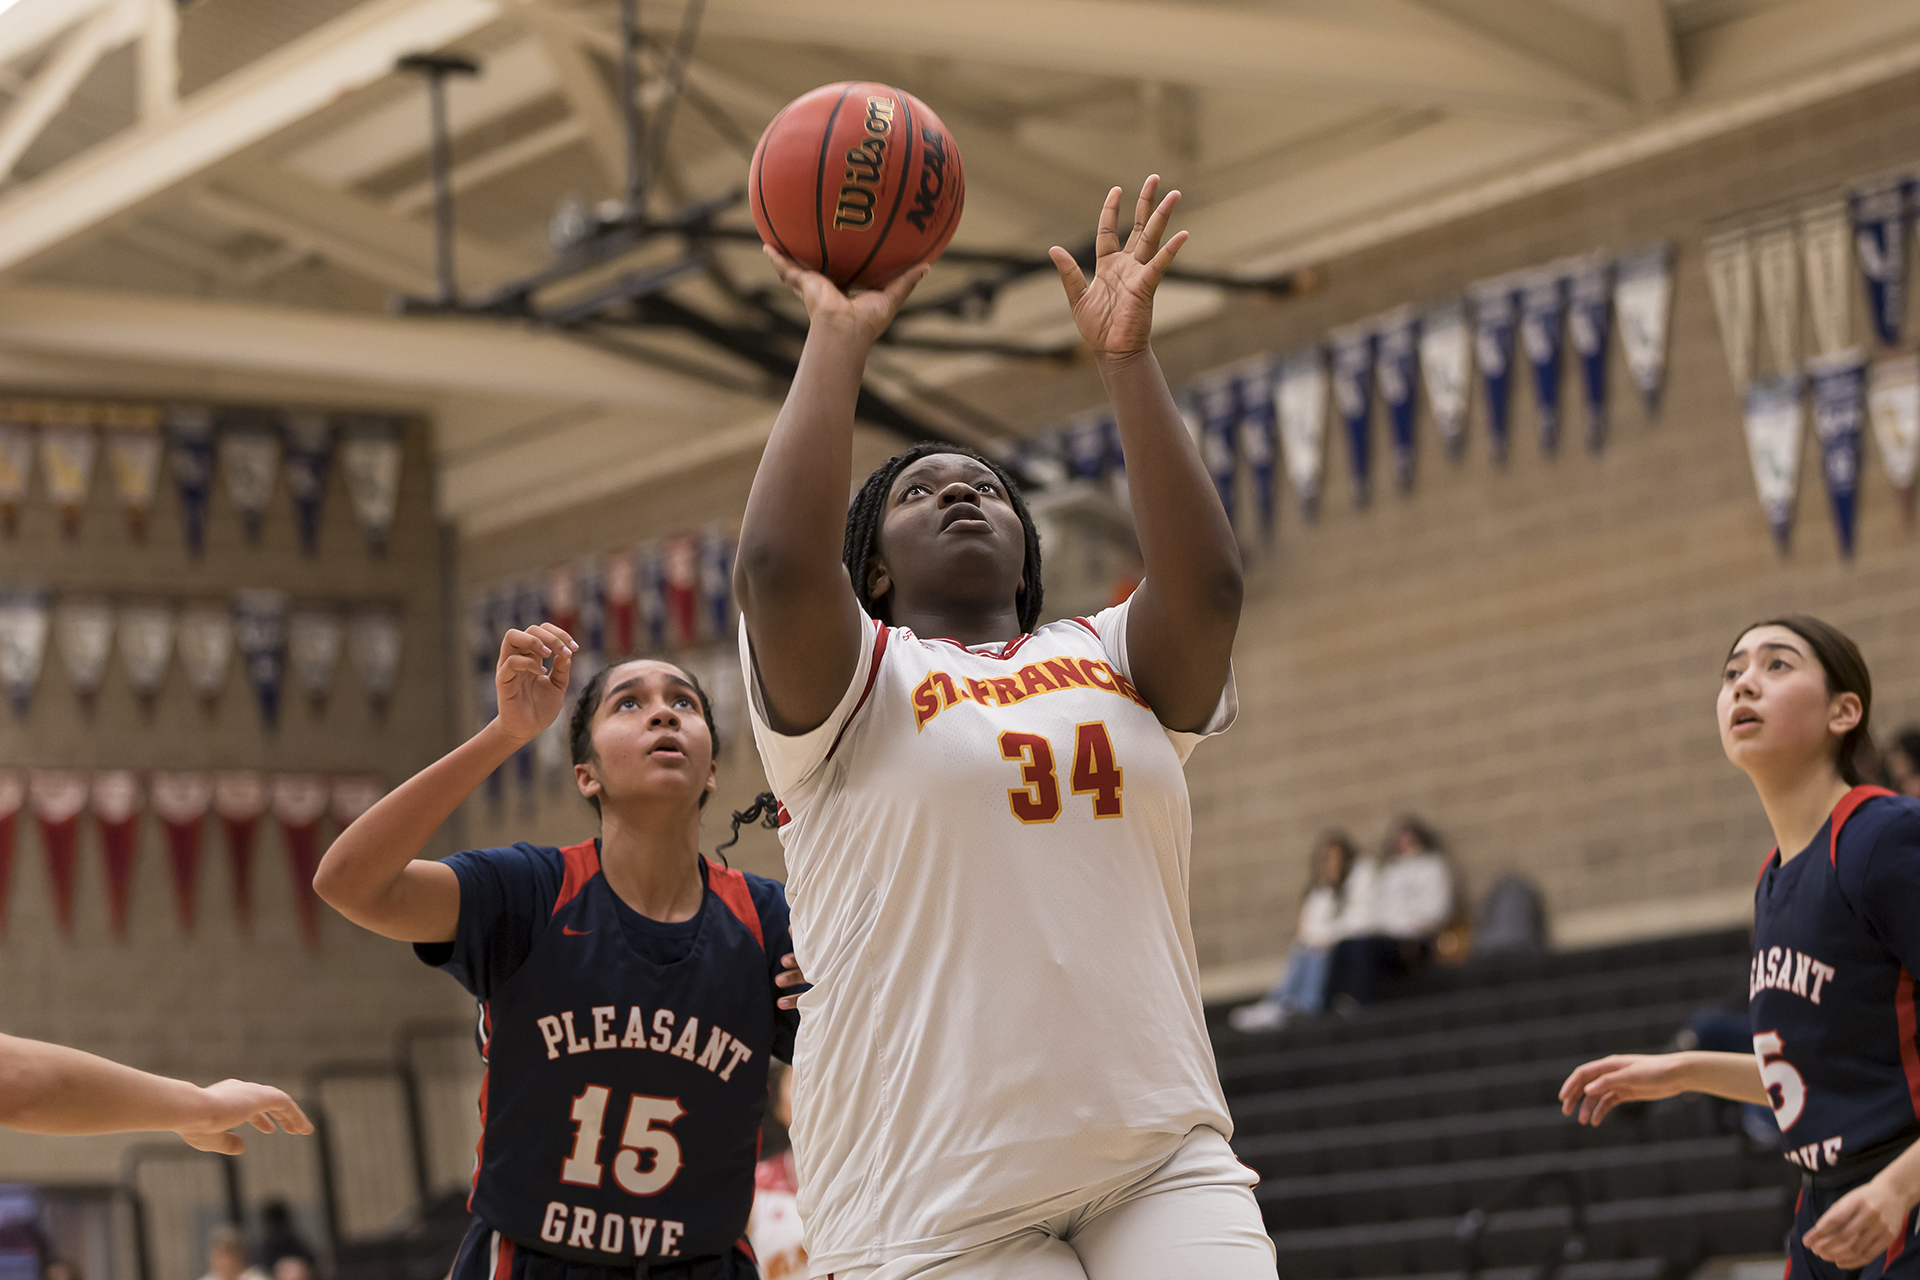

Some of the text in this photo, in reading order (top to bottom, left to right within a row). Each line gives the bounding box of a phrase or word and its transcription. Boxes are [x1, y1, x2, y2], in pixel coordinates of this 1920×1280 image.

[833, 96, 895, 231] Wilson
[906, 127, 946, 233] NCAA
[997, 720, 1123, 825] 34
[537, 1005, 752, 1083] PLEASANT
[1753, 1029, 1808, 1133] 5
[560, 1083, 688, 1197] 15
[541, 1201, 684, 1257] GROVE
